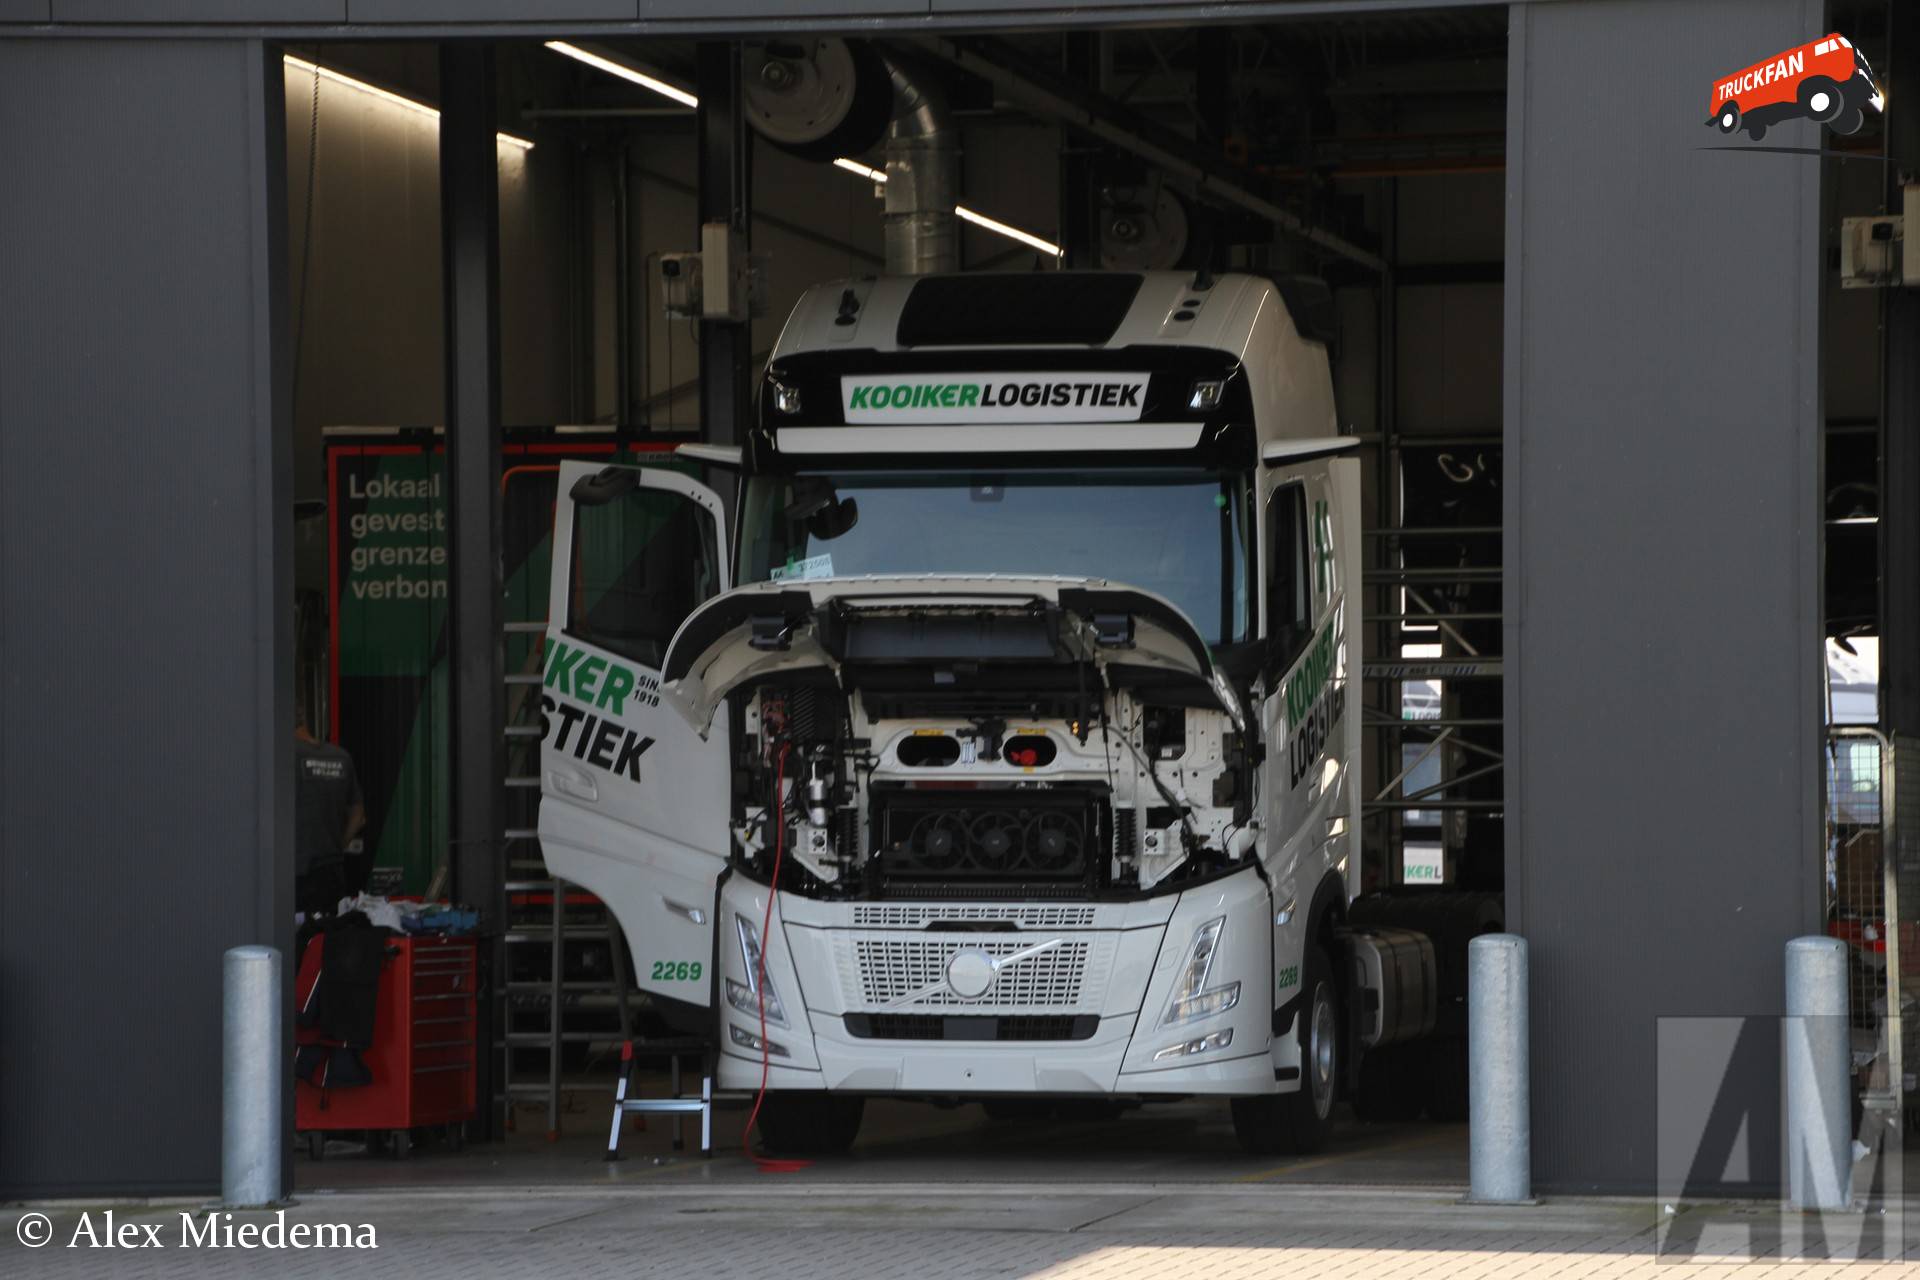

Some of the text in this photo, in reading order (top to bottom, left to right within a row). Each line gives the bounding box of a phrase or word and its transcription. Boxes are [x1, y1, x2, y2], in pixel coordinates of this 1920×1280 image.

[349, 473, 440, 498] Lokaal
[350, 508, 446, 539] gevest
[350, 545, 447, 572] grenze
[351, 574, 448, 599] verbon
[638, 674, 660, 692] SIN
[651, 960, 702, 981] 2269
